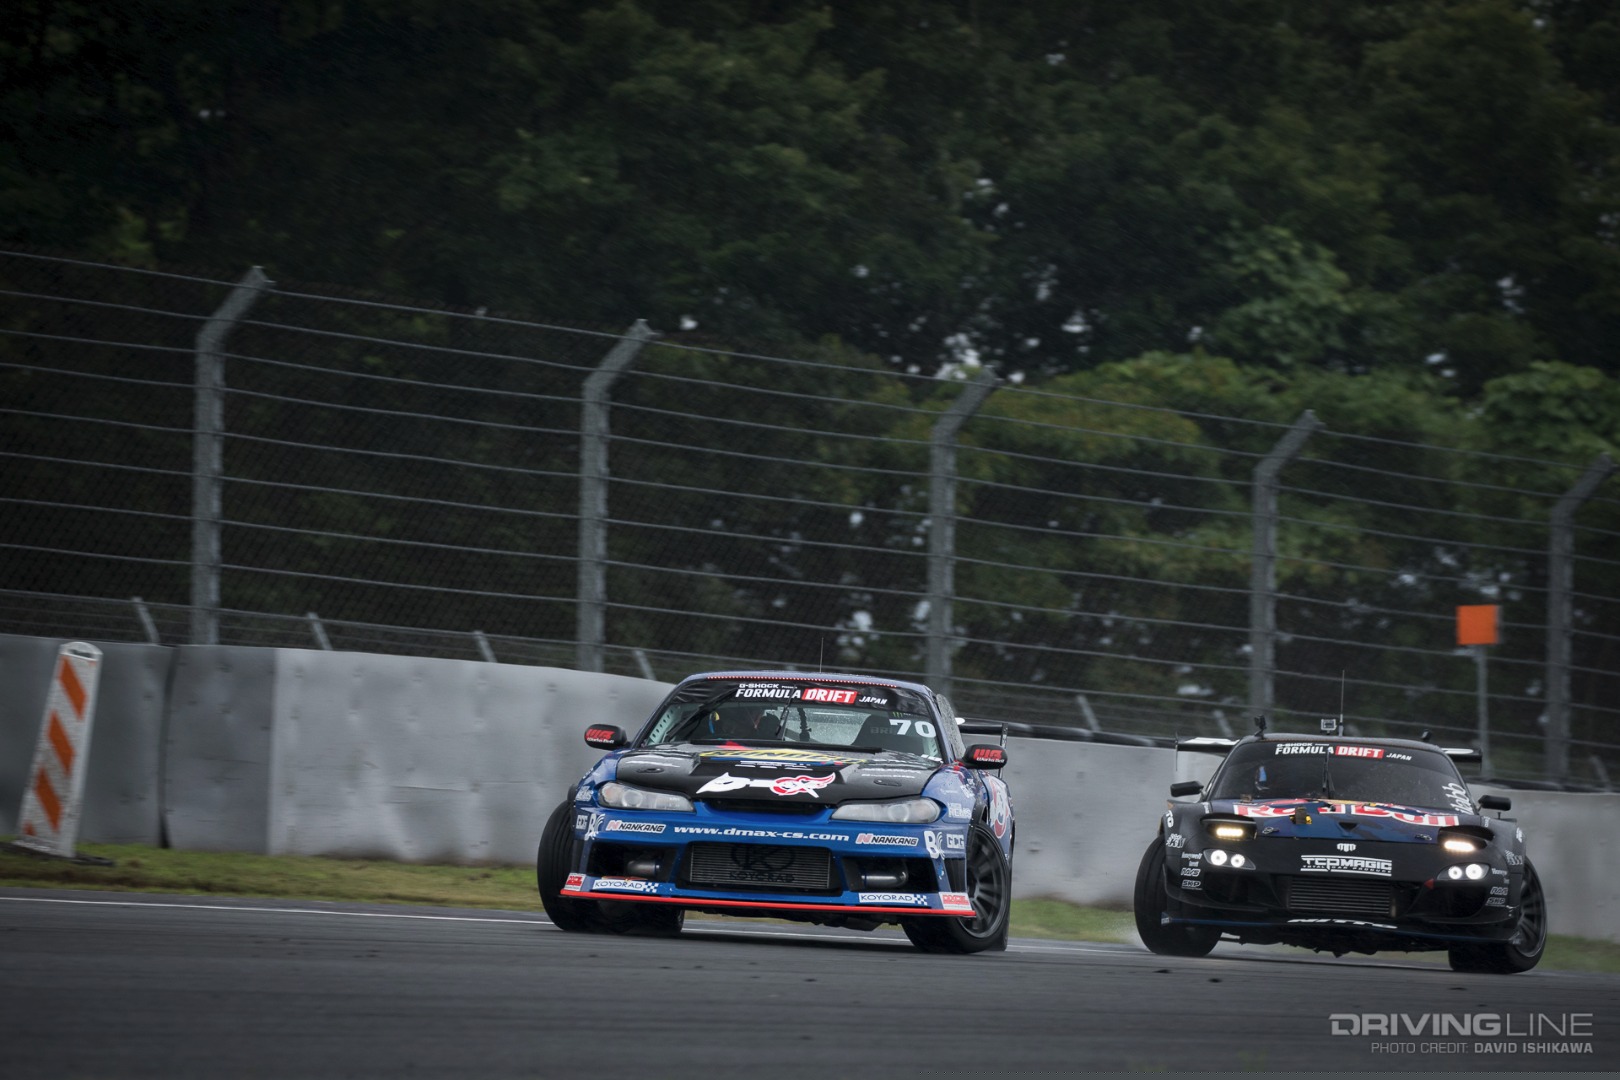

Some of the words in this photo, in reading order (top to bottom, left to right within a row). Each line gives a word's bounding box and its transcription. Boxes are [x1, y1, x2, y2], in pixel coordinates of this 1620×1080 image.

[735, 688, 802, 699] FORMULA
[804, 689, 854, 704] DRIFT
[859, 696, 887, 705] JAPAN
[889, 718, 937, 738] 70
[1274, 745, 1334, 755] FORMULA
[1337, 745, 1382, 758] DRIFT
[1386, 752, 1412, 761] JAPAN
[617, 821, 665, 833] NANKANG
[674, 827, 850, 842] www.dmax-cs.com
[871, 836, 918, 847] NANKANG
[595, 880, 643, 890] KOYORAD
[860, 894, 913, 902] KOYORAD
